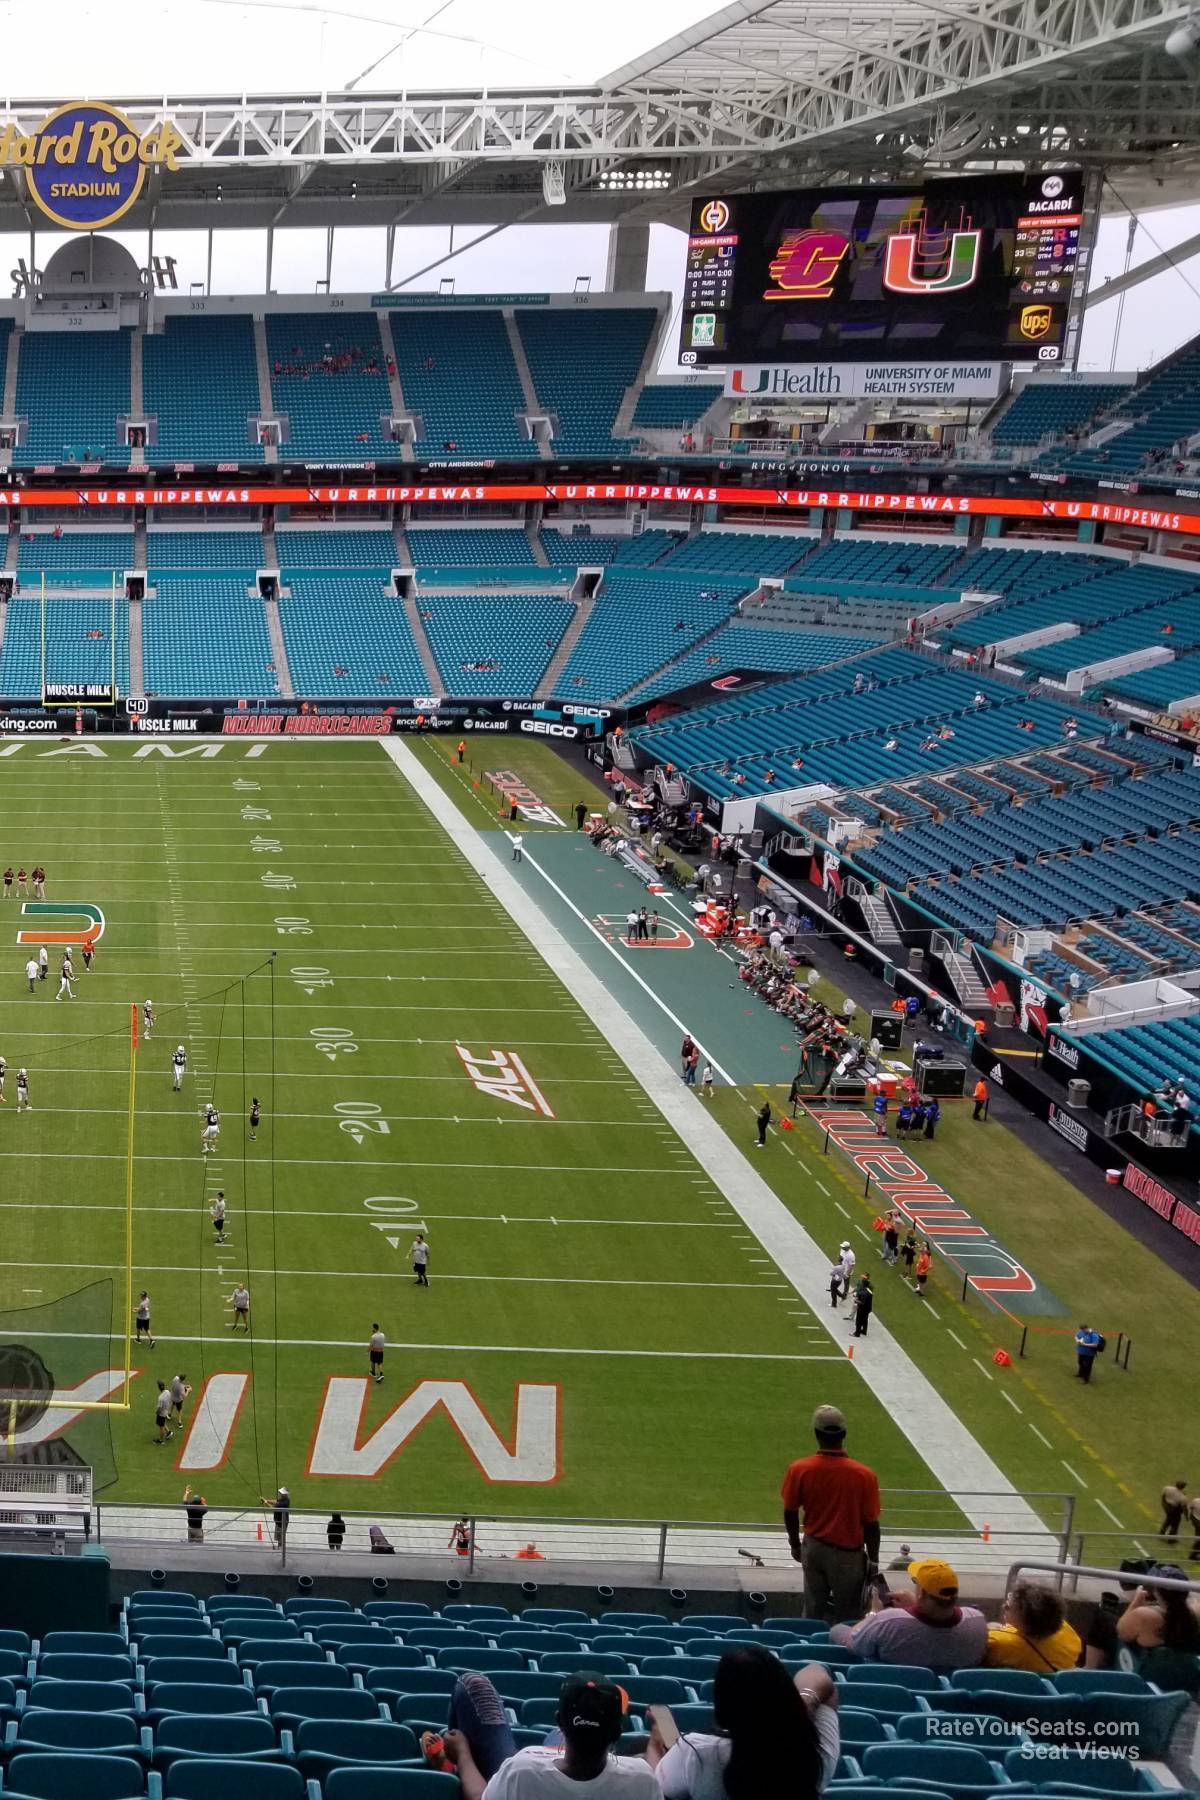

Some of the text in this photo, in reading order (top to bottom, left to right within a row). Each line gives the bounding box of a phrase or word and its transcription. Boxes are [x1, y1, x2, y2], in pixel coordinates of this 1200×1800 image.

[87, 120, 182, 173] Rock
[51, 182, 120, 197] STADIUM
[1028, 196, 1073, 212] BACARDÍ
[1023, 315, 1049, 334] ups
[683, 354, 696, 362] CC
[1041, 348, 1056, 358] CC
[865, 367, 992, 379] UNIVERSITY OF MIAMI
[864, 382, 955, 393] HEALTH SYSTEM
[751, 462, 786, 471] RING
[799, 462, 850, 473] HONOR
[46, 684, 111, 696] MUSCLE MILK
[513, 700, 546, 710] BACARDÍ
[562, 704, 611, 718] GEICO
[172, 718, 198, 731] MILK
[222, 713, 392, 734] MIAMI HURRICANES
[474, 720, 508, 730] BACARDÍ
[520, 720, 578, 738] GEICO
[274, 917, 314, 935] 50
[289, 967, 335, 988] 40
[309, 1027, 360, 1053] 30
[455, 1045, 538, 1112] ACC
[333, 1101, 391, 1134] 20
[1123, 1162, 1176, 1222] MIAMI
[363, 1196, 430, 1234] 10
